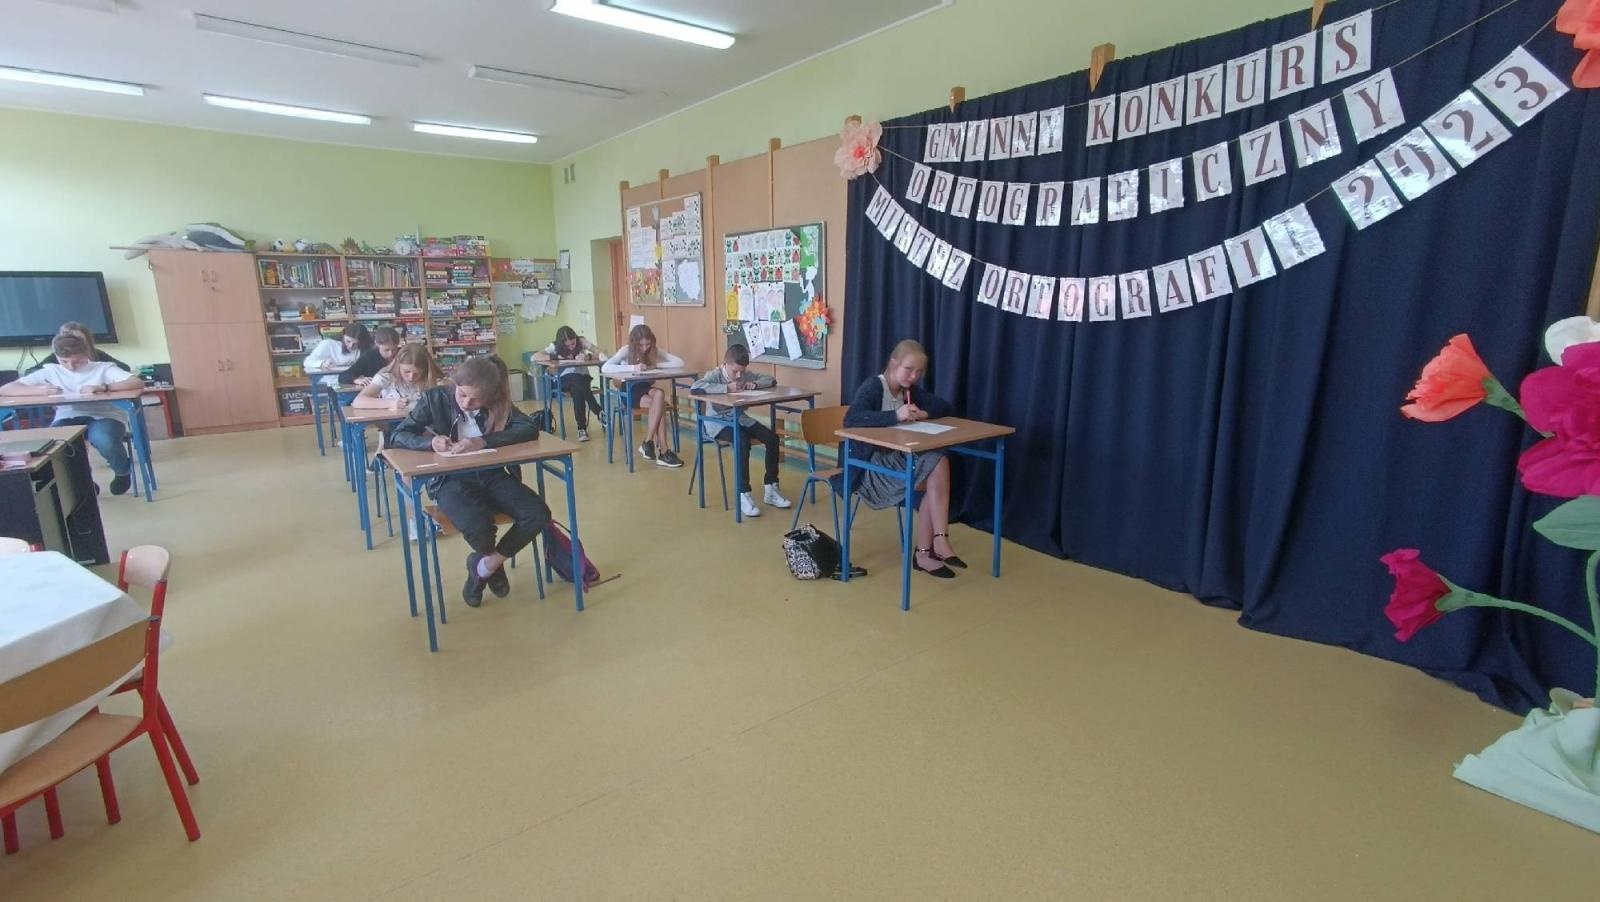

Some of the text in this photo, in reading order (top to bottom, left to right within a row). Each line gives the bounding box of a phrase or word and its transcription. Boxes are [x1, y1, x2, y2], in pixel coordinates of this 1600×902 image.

[911, 78, 1386, 221] ORTOGRAFICZNY
[928, 22, 1358, 159] GMINNY KONKURS
[1347, 65, 1549, 219] 2023
